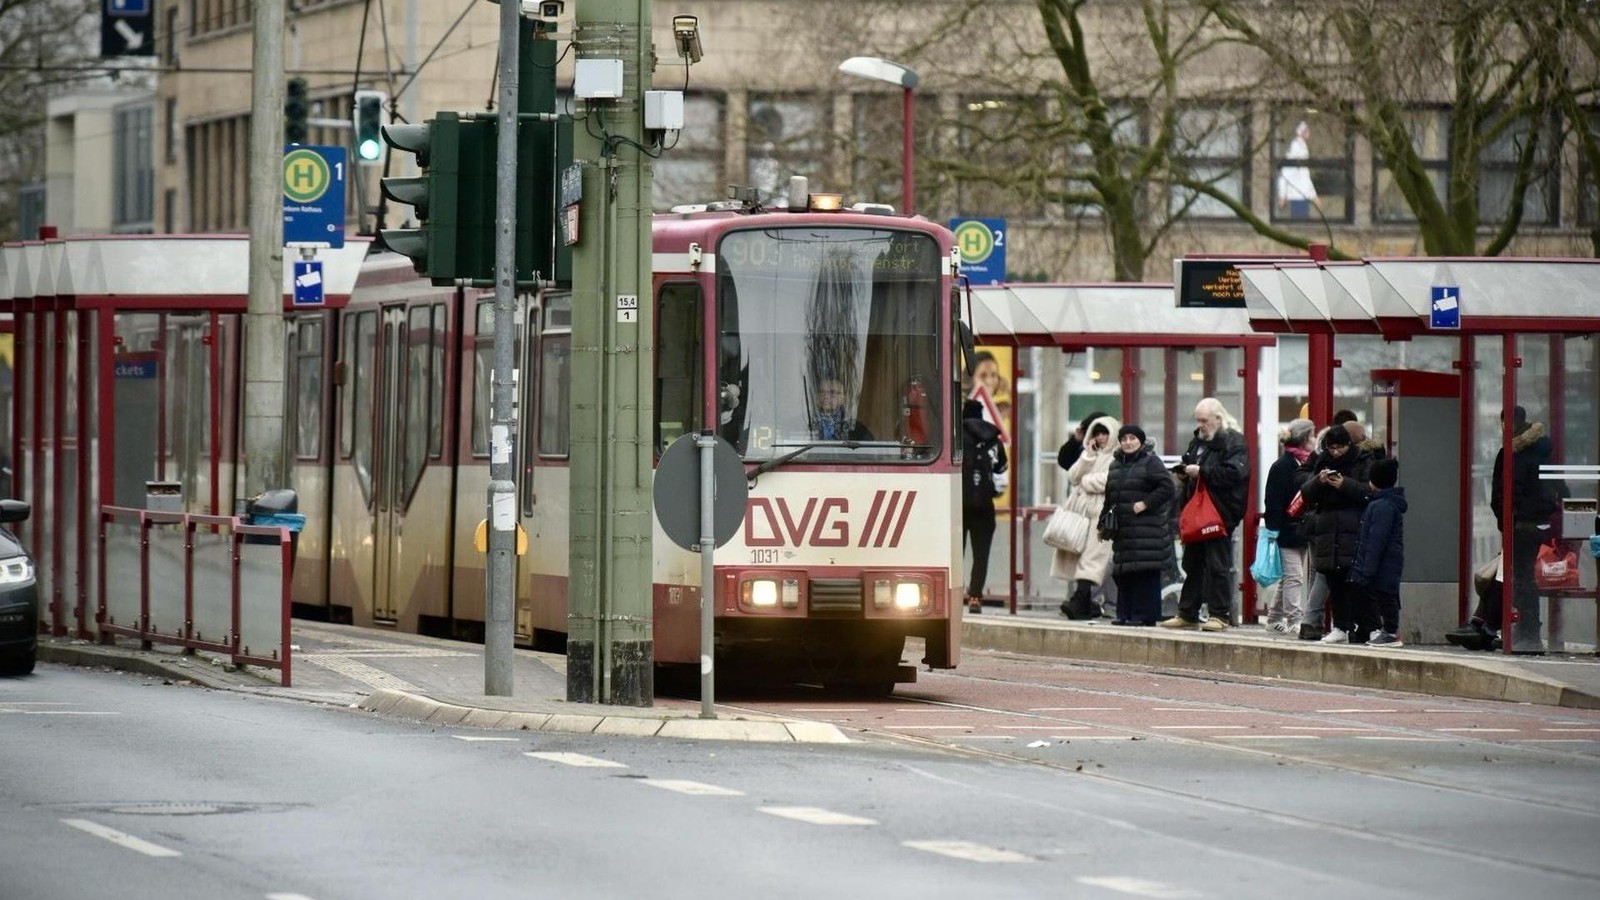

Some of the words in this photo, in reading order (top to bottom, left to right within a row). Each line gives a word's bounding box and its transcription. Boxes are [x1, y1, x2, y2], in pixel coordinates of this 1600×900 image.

[294, 164, 314, 188] H
[335, 162, 343, 181] 1
[964, 233, 981, 252] H
[994, 230, 1003, 247] 2
[619, 297, 636, 307] 15,4
[623, 311, 630, 320] 1
[753, 426, 772, 450] 12
[744, 497, 849, 547] DVG
[750, 549, 779, 564] 1031
